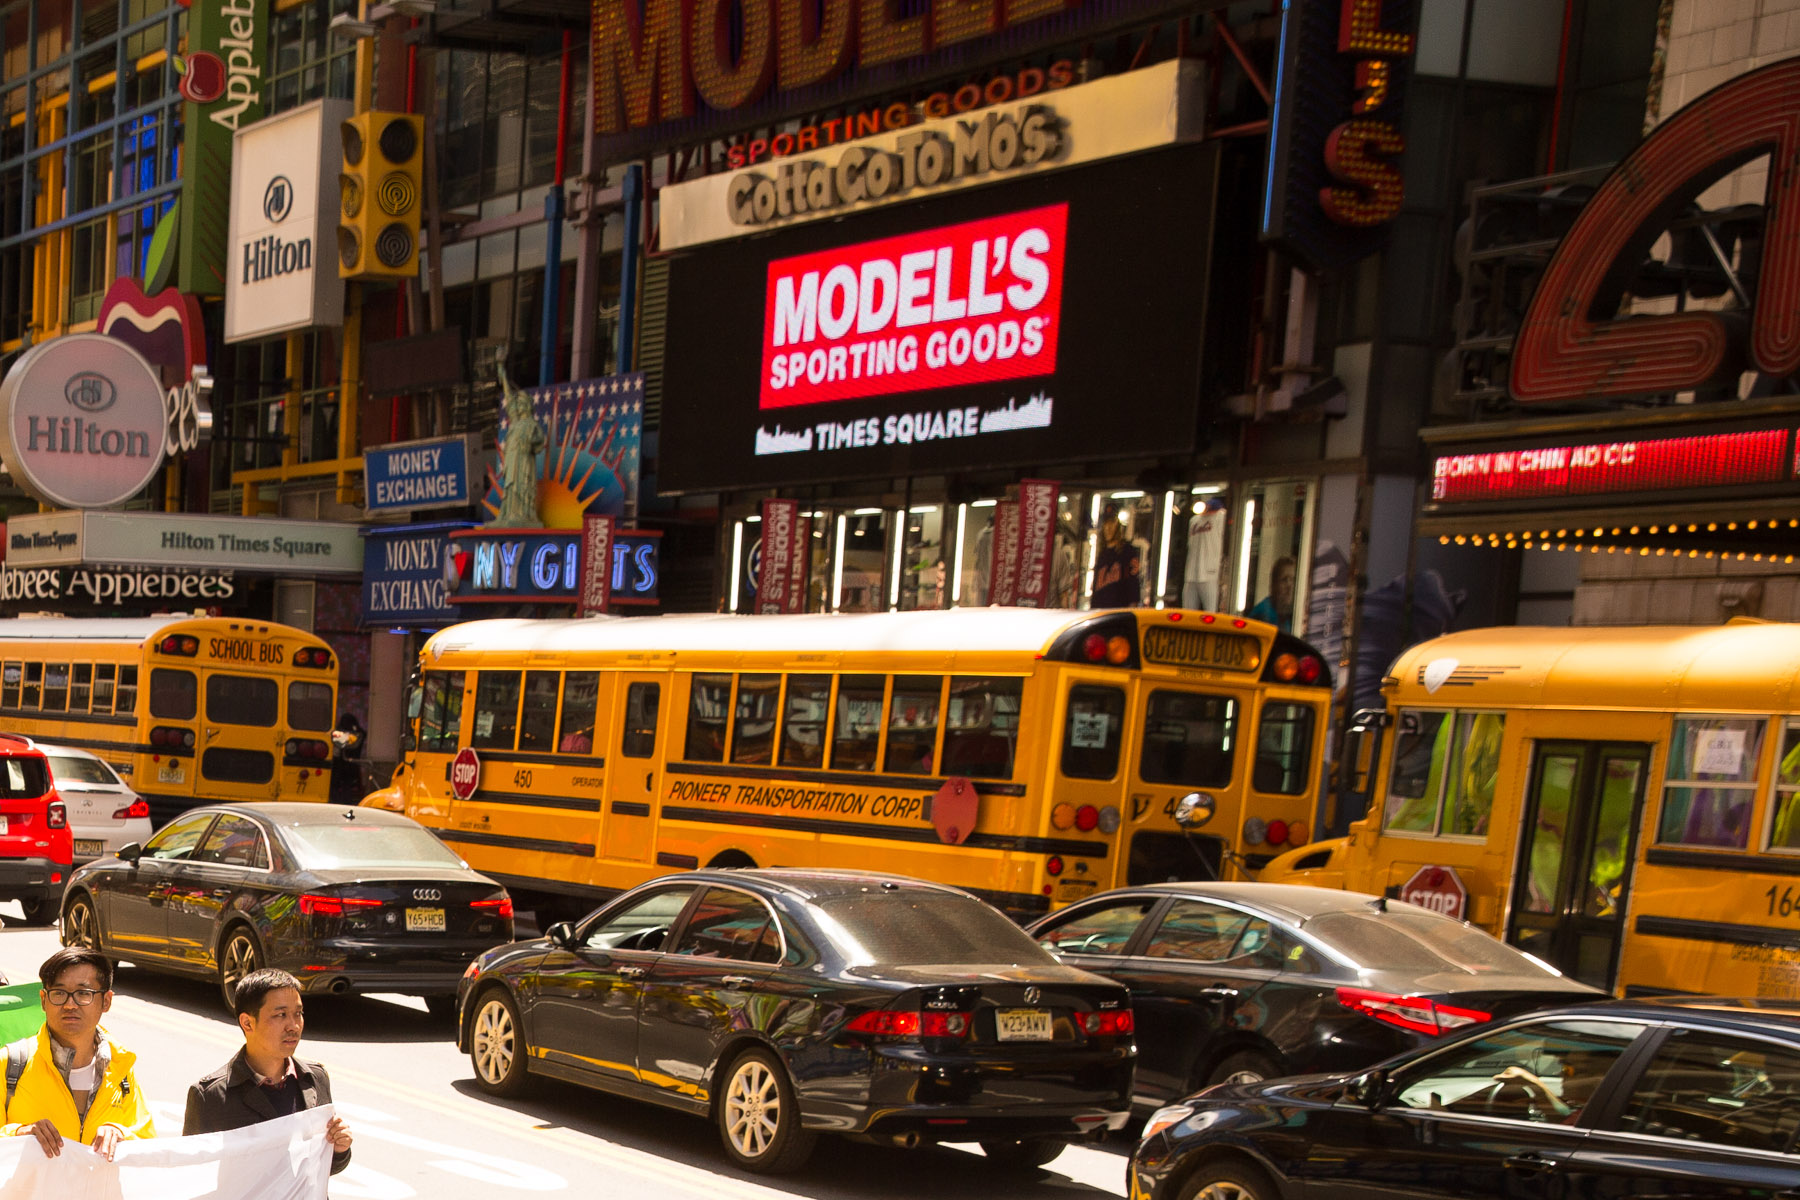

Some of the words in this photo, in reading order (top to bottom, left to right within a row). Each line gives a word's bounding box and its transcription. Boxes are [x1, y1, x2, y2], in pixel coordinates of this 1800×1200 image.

[726, 103, 909, 169] SPORTING
[922, 59, 1075, 120] GOODS
[726, 163, 831, 228] Gotta
[835, 144, 899, 200] Go
[900, 130, 954, 191] To
[242, 235, 312, 285] Hilton
[773, 229, 1051, 348] MODELL'S
[769, 337, 918, 391] SPORTING
[924, 319, 1044, 368] GOODS
[26, 415, 150, 458] Hilton
[816, 415, 880, 451] TIMES
[883, 407, 980, 446] SQUARE
[388, 449, 442, 476] MONEY
[376, 473, 458, 503] EXCHANGE
[1020, 484, 1035, 547] SPORTING
[11, 532, 32, 550] Hilton
[161, 531, 215, 551] Hilton
[218, 533, 269, 553] Times
[272, 536, 333, 558] Square
[384, 537, 443, 573] MONEY
[768, 502, 792, 601] MODELL'S
[1025, 484, 1053, 595] MODELL'S
[531, 541, 657, 594] GITS
[590, 516, 609, 608] MODELL'S
[209, 638, 256, 662] SCHOOL
[259, 642, 284, 664] BUS
[1143, 625, 1210, 662] SCHOOL
[1212, 635, 1246, 666] BUS
[454, 763, 476, 784] STOP
[513, 769, 533, 789] 450
[668, 780, 732, 801] PIONEER
[733, 785, 869, 816] TRANSPORTATION
[870, 796, 922, 820] CORP.
